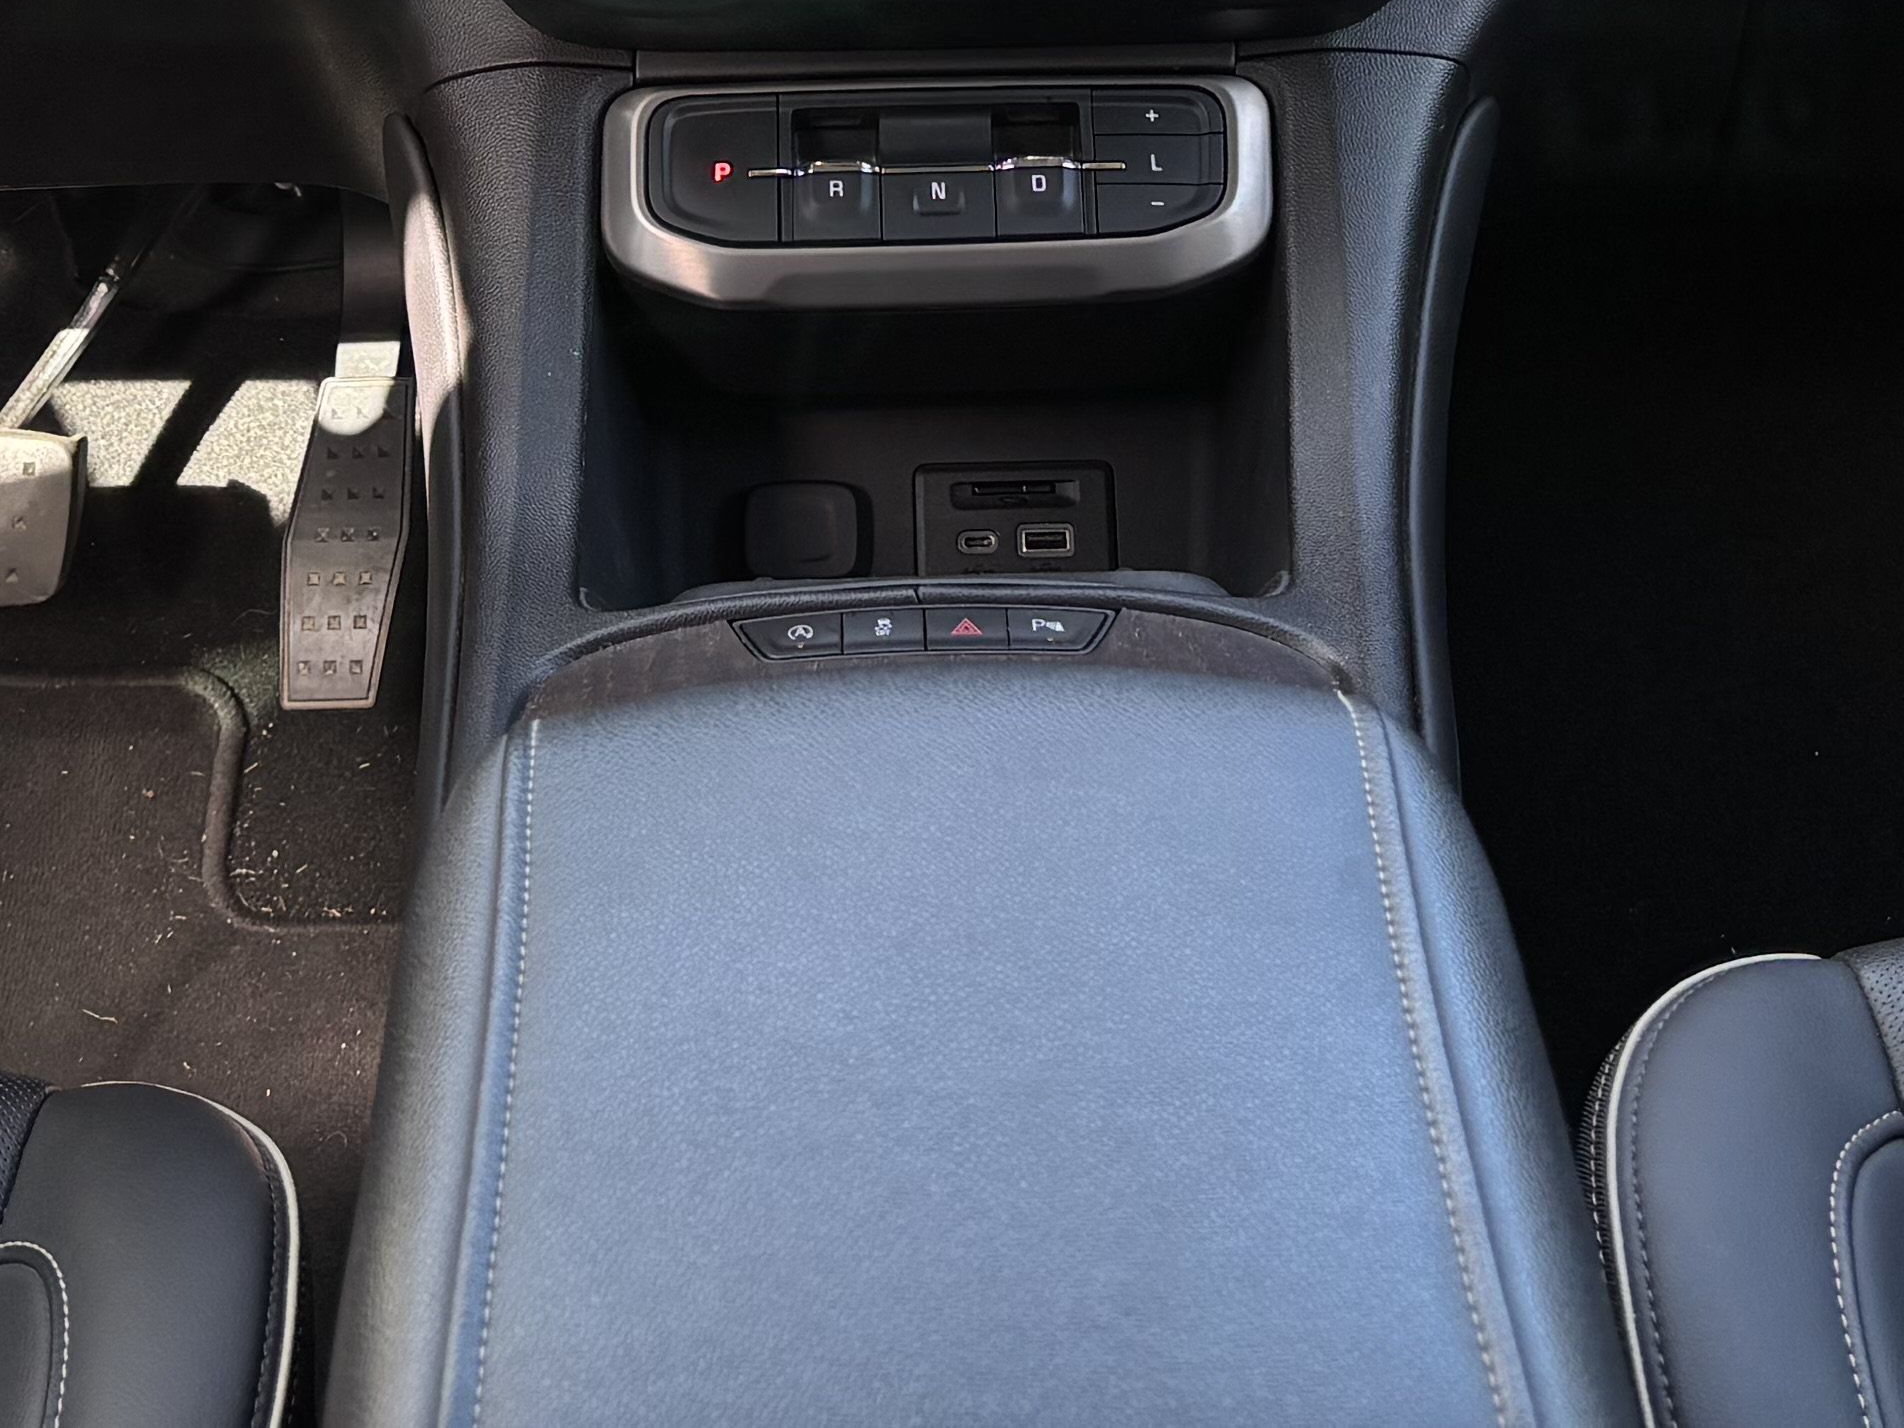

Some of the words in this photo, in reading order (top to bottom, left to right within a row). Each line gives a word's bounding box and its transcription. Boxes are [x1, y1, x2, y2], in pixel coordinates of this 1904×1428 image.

[713, 162, 732, 182] P
[1150, 154, 1162, 172] L
[829, 179, 845, 197] R
[931, 182, 946, 200] N
[1031, 174, 1047, 193] D
